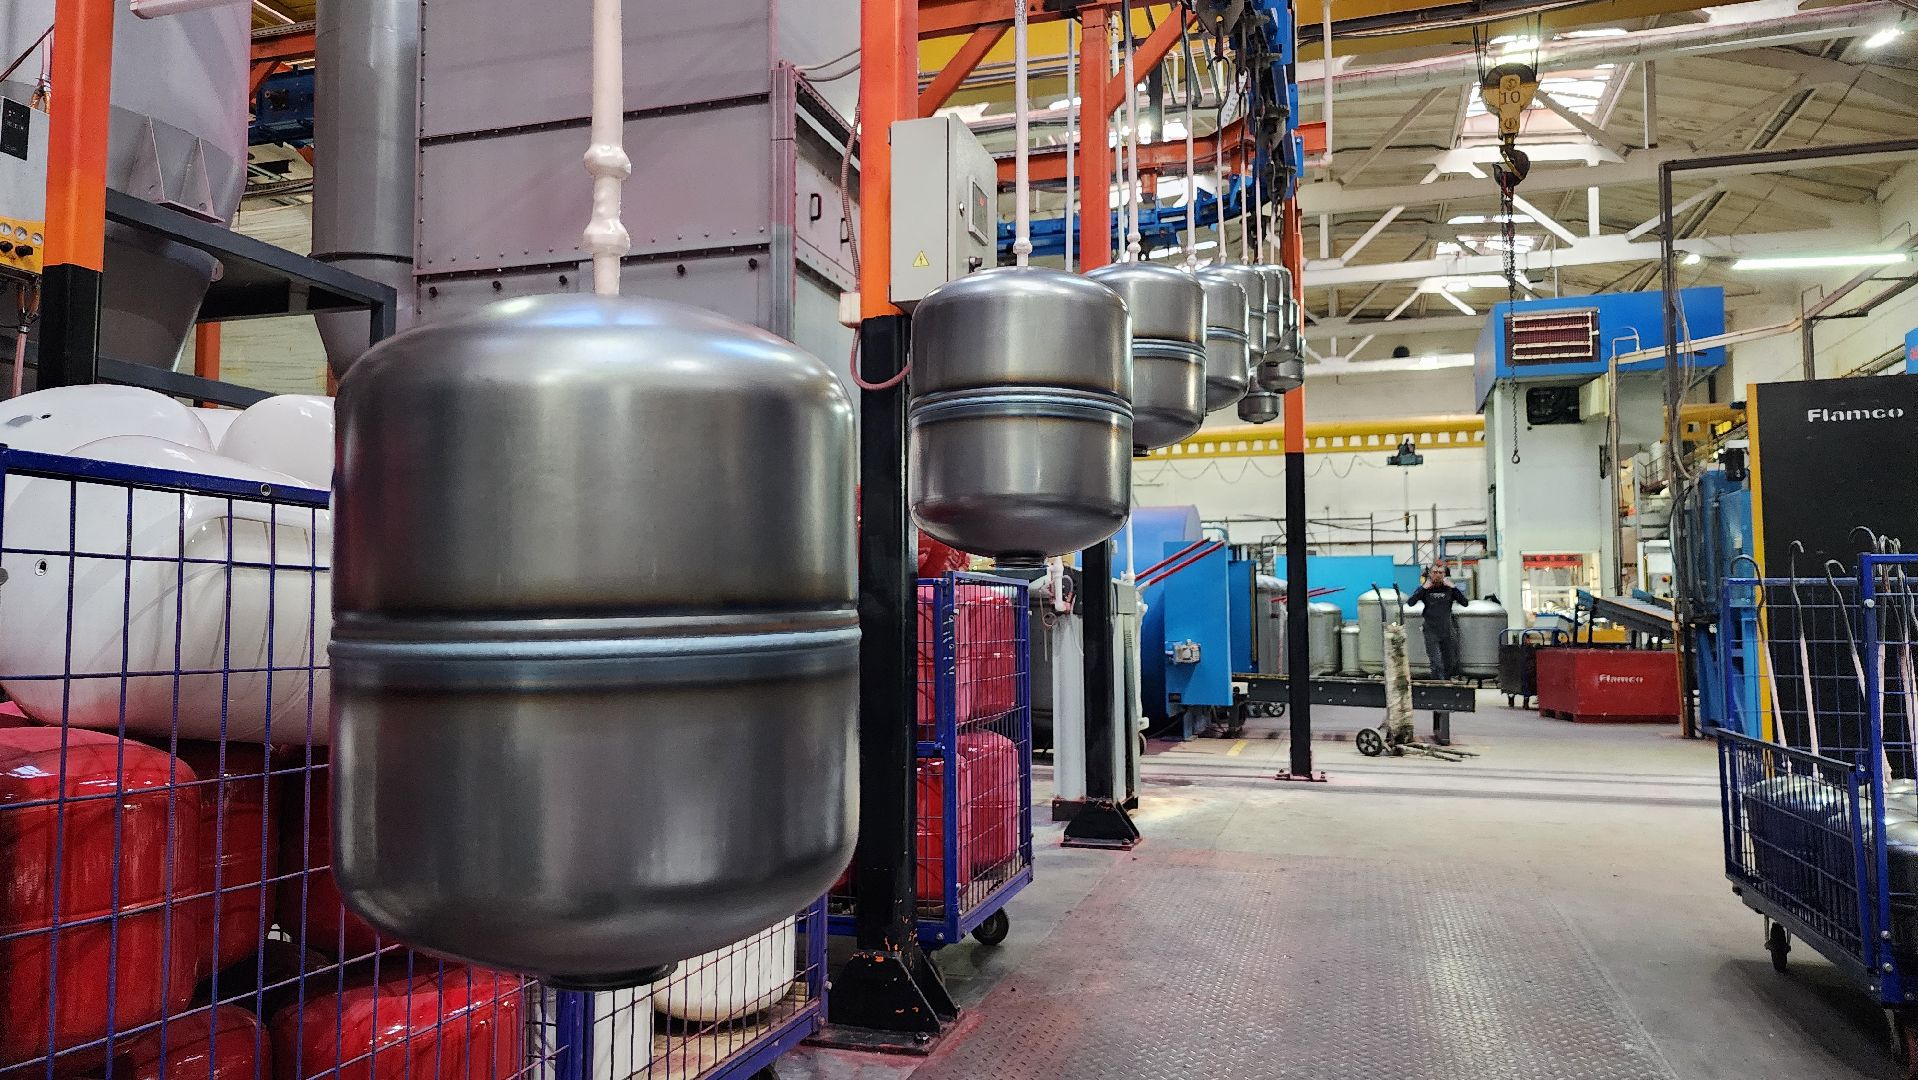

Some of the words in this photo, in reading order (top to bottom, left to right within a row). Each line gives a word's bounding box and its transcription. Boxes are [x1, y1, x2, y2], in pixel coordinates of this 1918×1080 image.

[1501, 91, 1521, 105] 10
[1807, 408, 1904, 423] Flamco
[1599, 674, 1644, 684] Flamco
